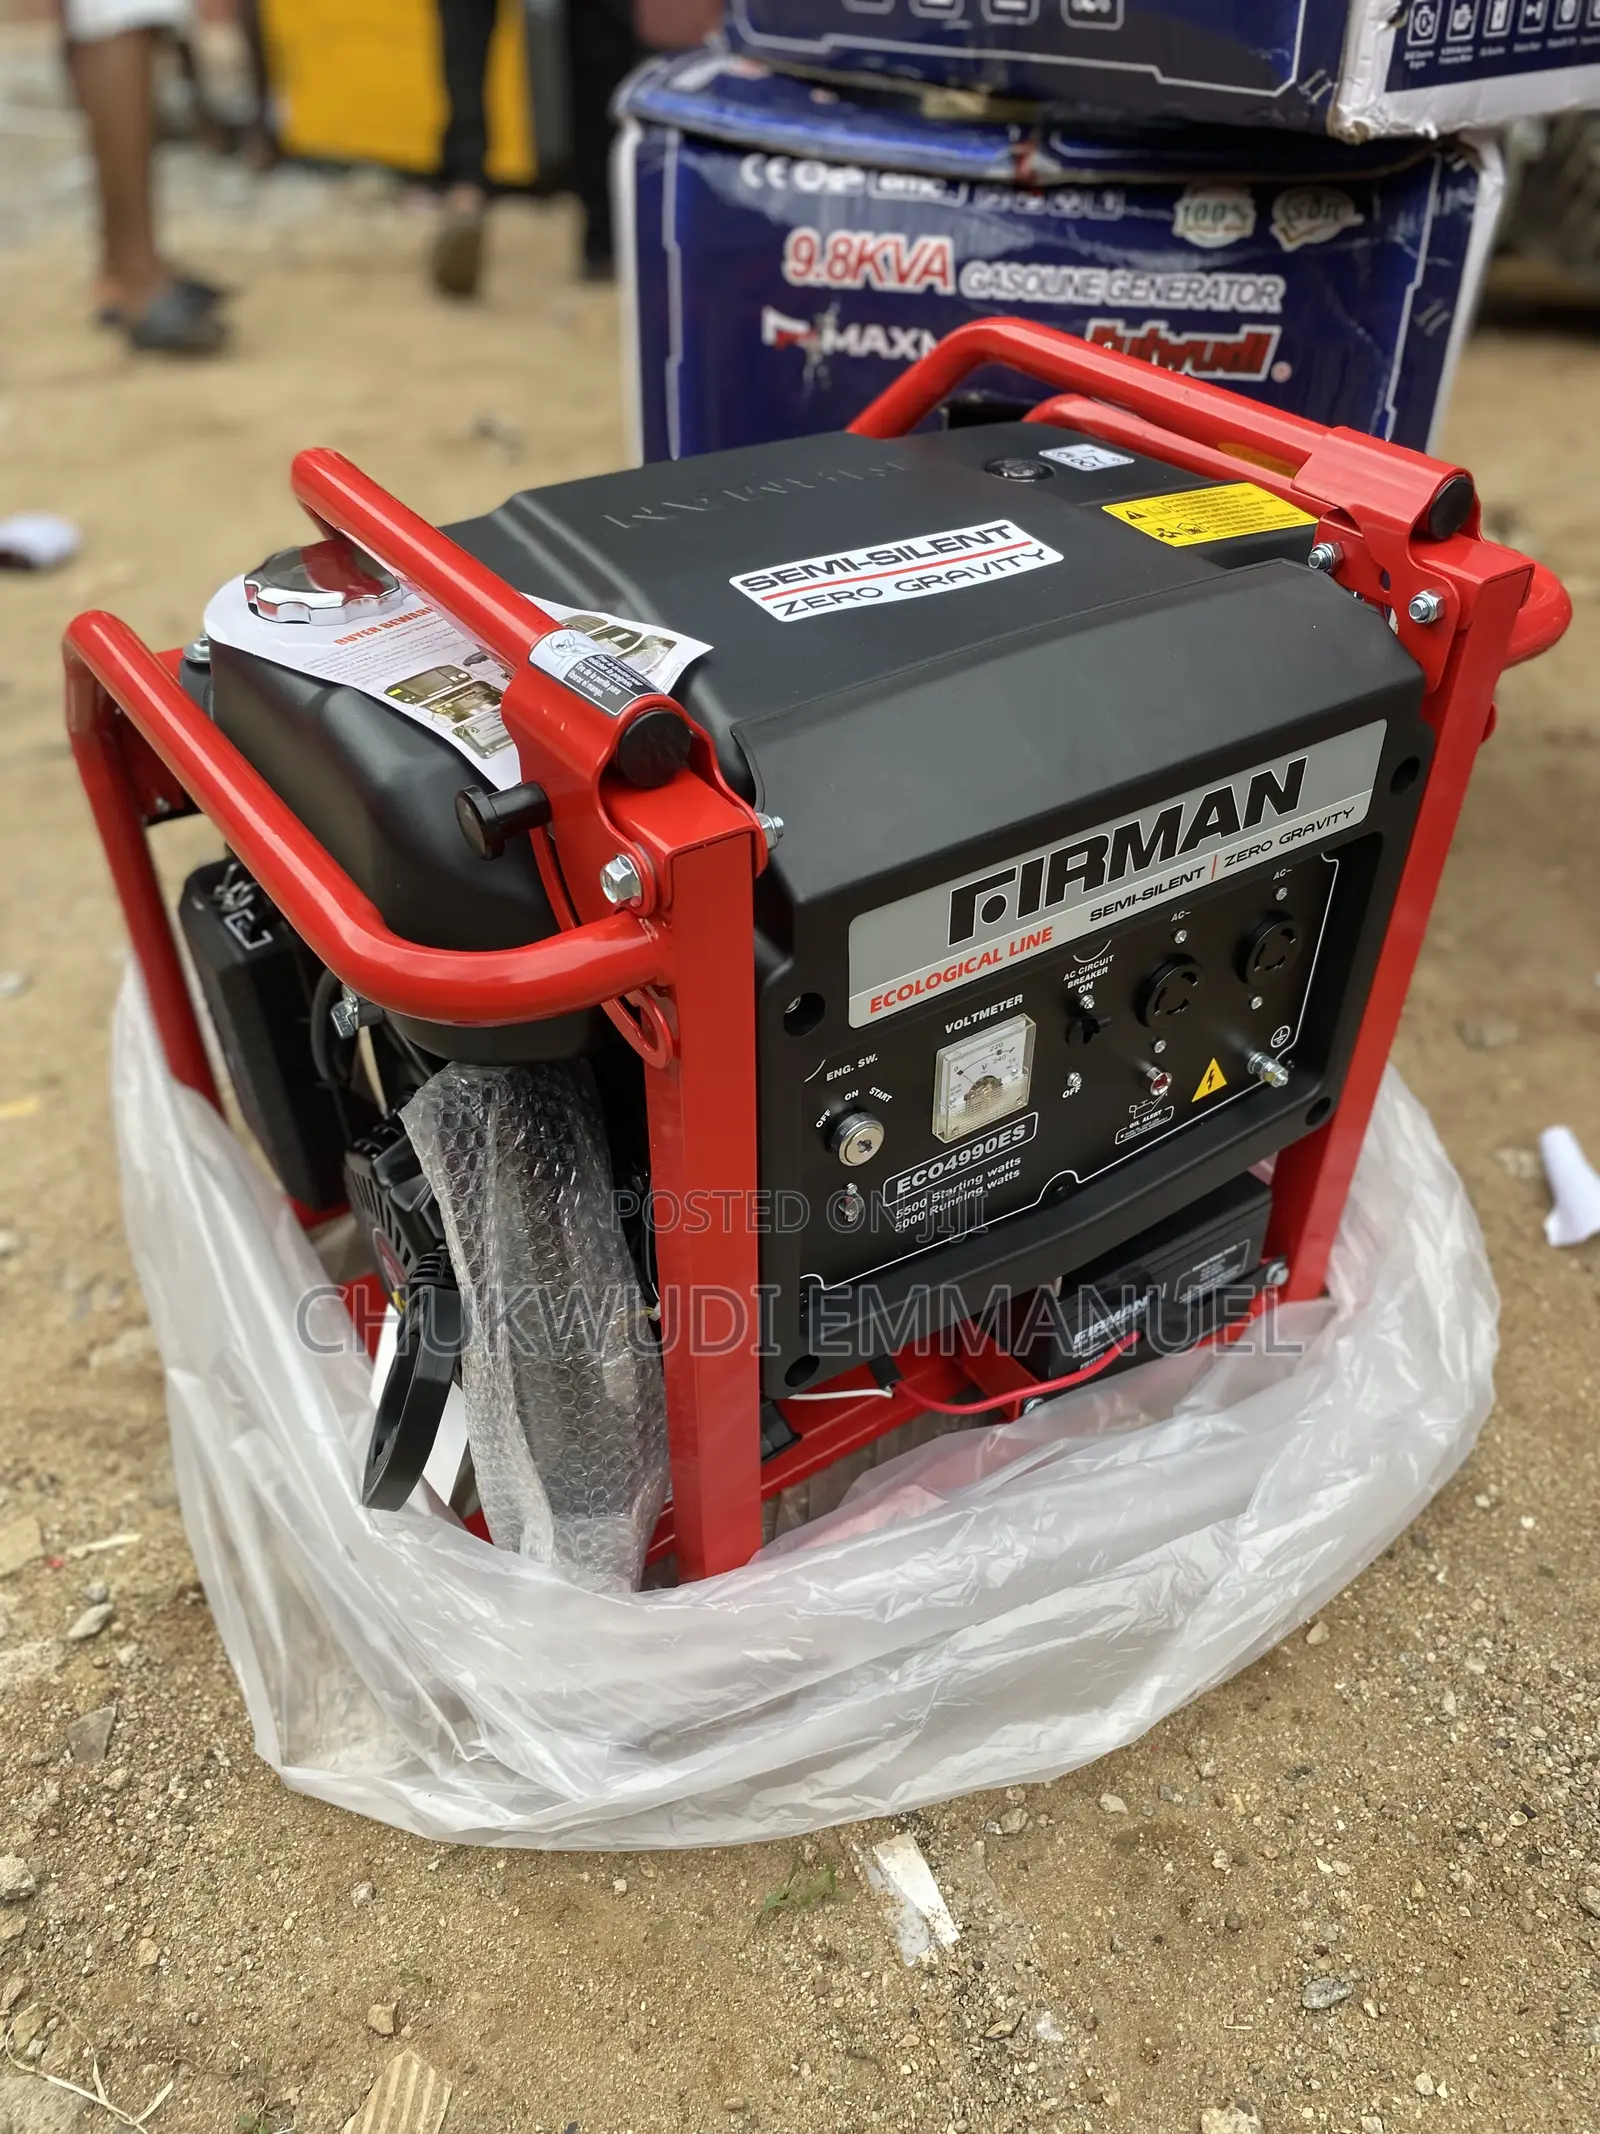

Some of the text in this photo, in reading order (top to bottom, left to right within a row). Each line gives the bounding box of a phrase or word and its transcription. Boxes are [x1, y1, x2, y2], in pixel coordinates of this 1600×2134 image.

[785, 231, 1286, 313] 9.8KVA GASOLINE GENERATOR
[740, 524, 1010, 592] SEMI-SILENT
[772, 548, 1044, 617] ZERO GRAVITY
[333, 626, 382, 646] BUYER
[947, 756, 1308, 948] FIRMAN
[1090, 806, 1355, 922] SEMI-SILENT ZERO GRAVITY
[870, 926, 1053, 1014] ECOLOGICAL LINE
[1063, 954, 1115, 981] AC CIRCUIT
[1067, 966, 1108, 989] BREAKER
[1078, 981, 1094, 994] ON
[945, 993, 1024, 1035] VOLTMETER
[826, 1053, 879, 1082] ENG. SW.
[844, 1089, 859, 1101] ON
[869, 1086, 893, 1103] START
[1062, 1085, 1082, 1099] OFF
[815, 1109, 831, 1128] OFF
[1141, 1109, 1163, 1124] ALERT
[897, 1124, 1026, 1196] ECO4990ES
[895, 1156, 1022, 1220] 5500 Starting watts
[895, 1169, 1020, 1233] 5000 Running watts
